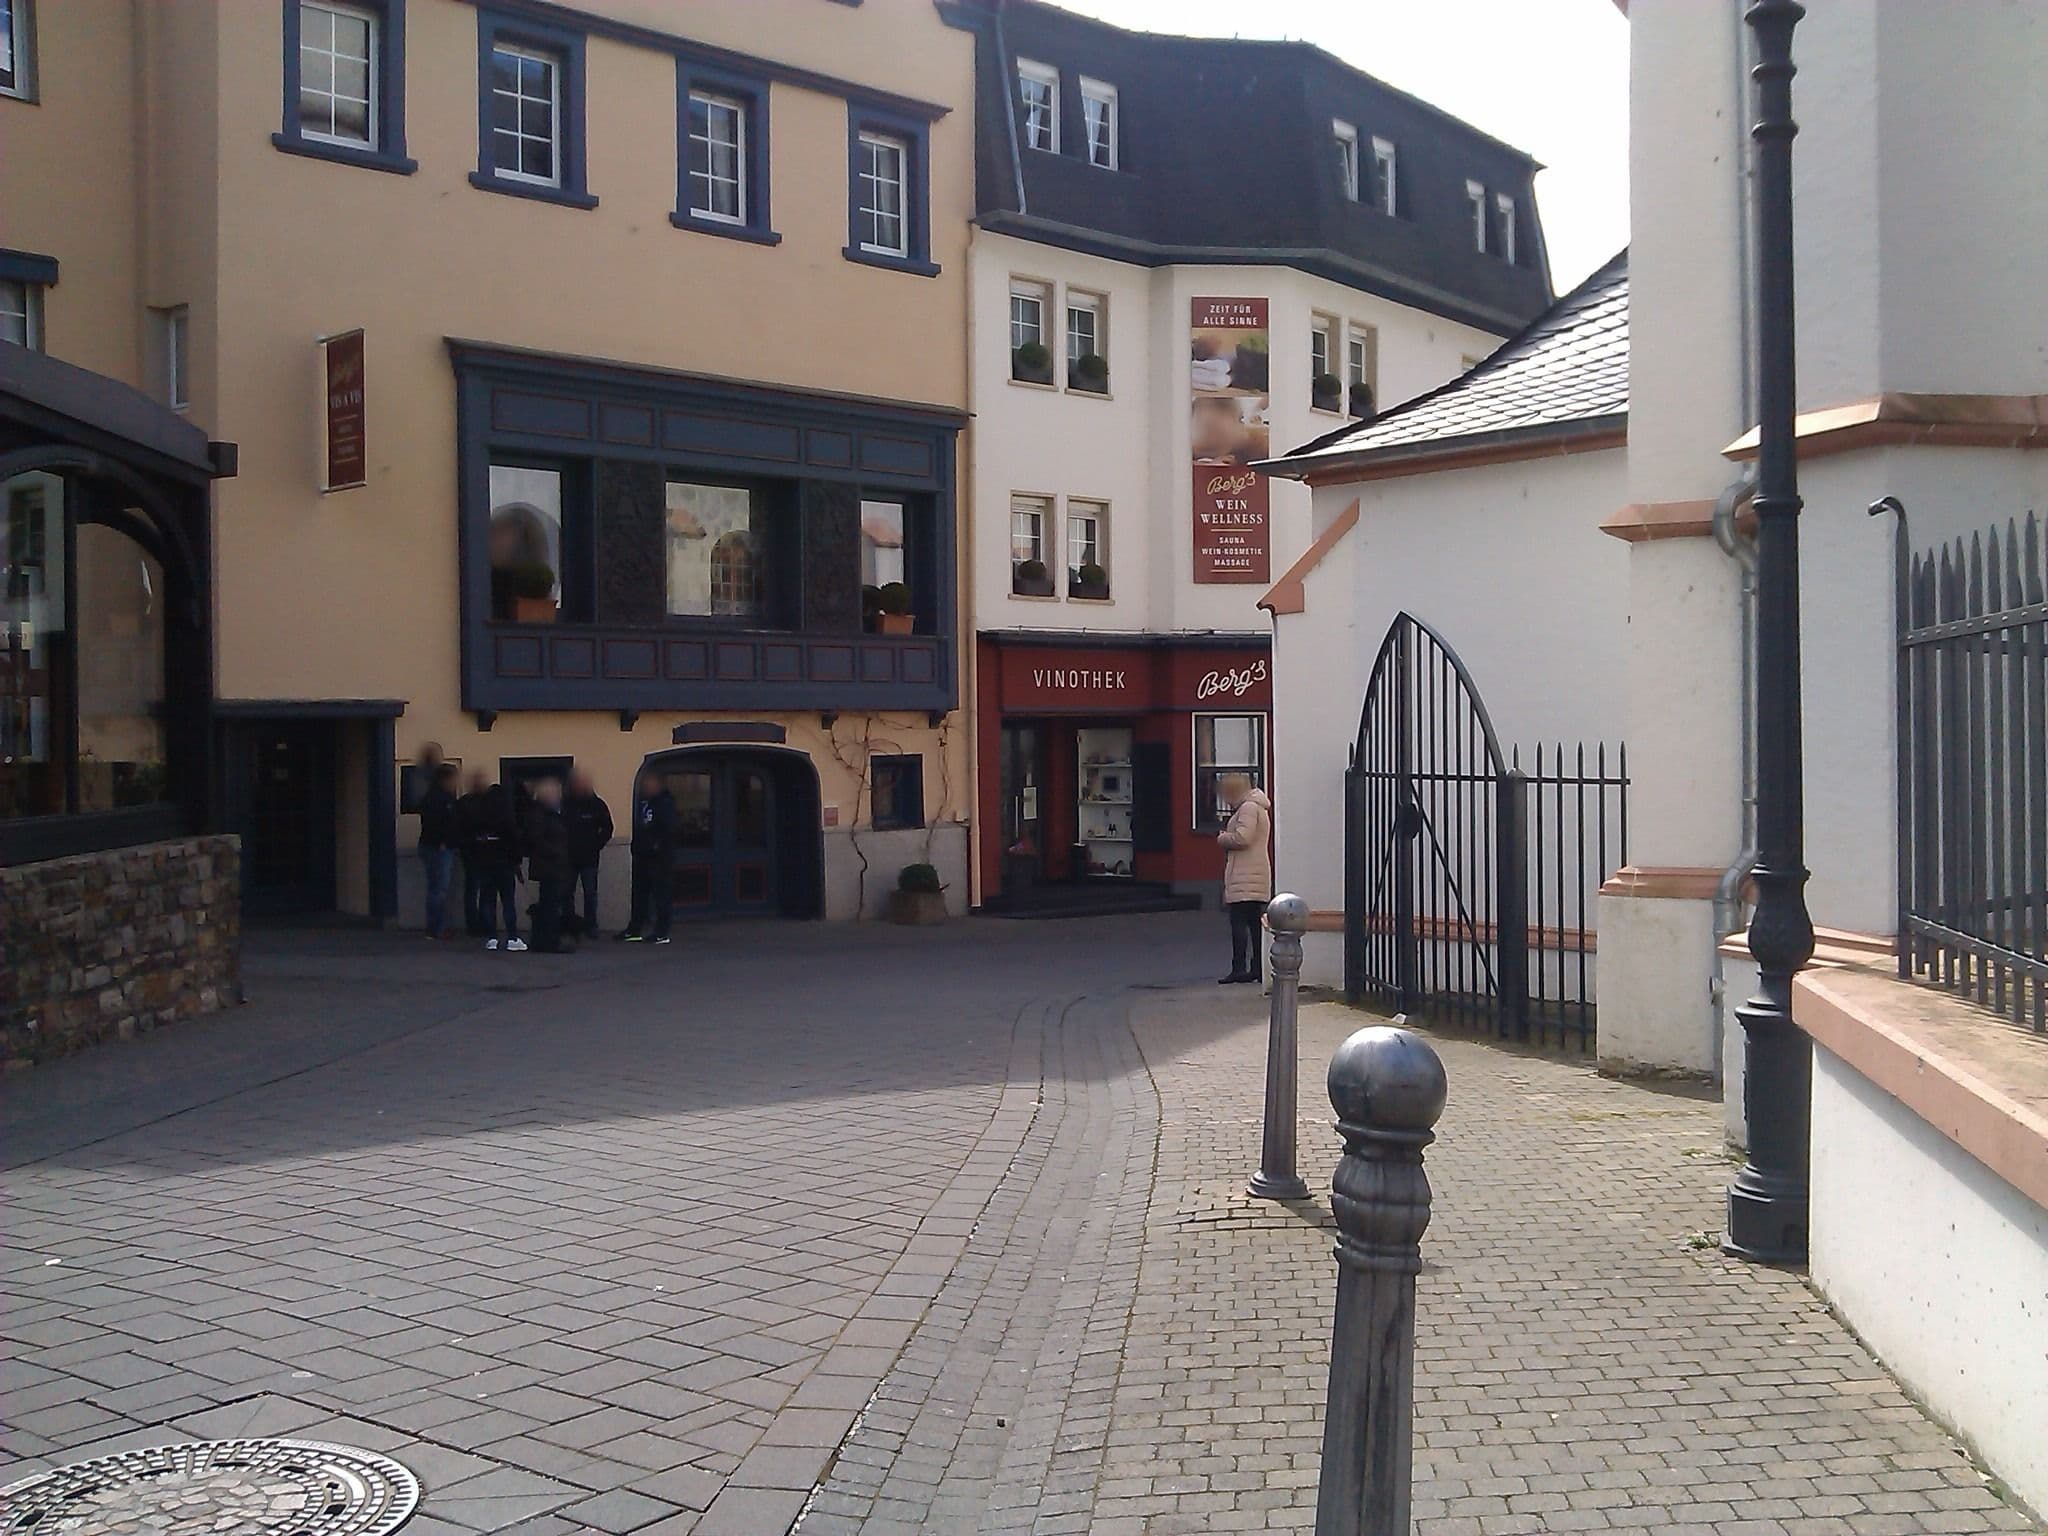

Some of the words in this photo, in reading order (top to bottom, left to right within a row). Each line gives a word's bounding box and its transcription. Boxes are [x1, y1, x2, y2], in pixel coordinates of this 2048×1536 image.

[1210, 304, 1230, 313] ZEIT
[1203, 316, 1225, 325] ALLE
[1229, 316, 1257, 325] SINNE
[1207, 471, 1256, 495] Berg's
[1216, 499, 1248, 510] WEIN
[1200, 513, 1264, 524] WELLNESS
[1219, 536, 1245, 544] SAUNA
[1201, 547, 1263, 555] WEIN-KOSMETIK
[1033, 669, 1126, 689] VINOTHEK
[1196, 659, 1266, 700] Berg's
